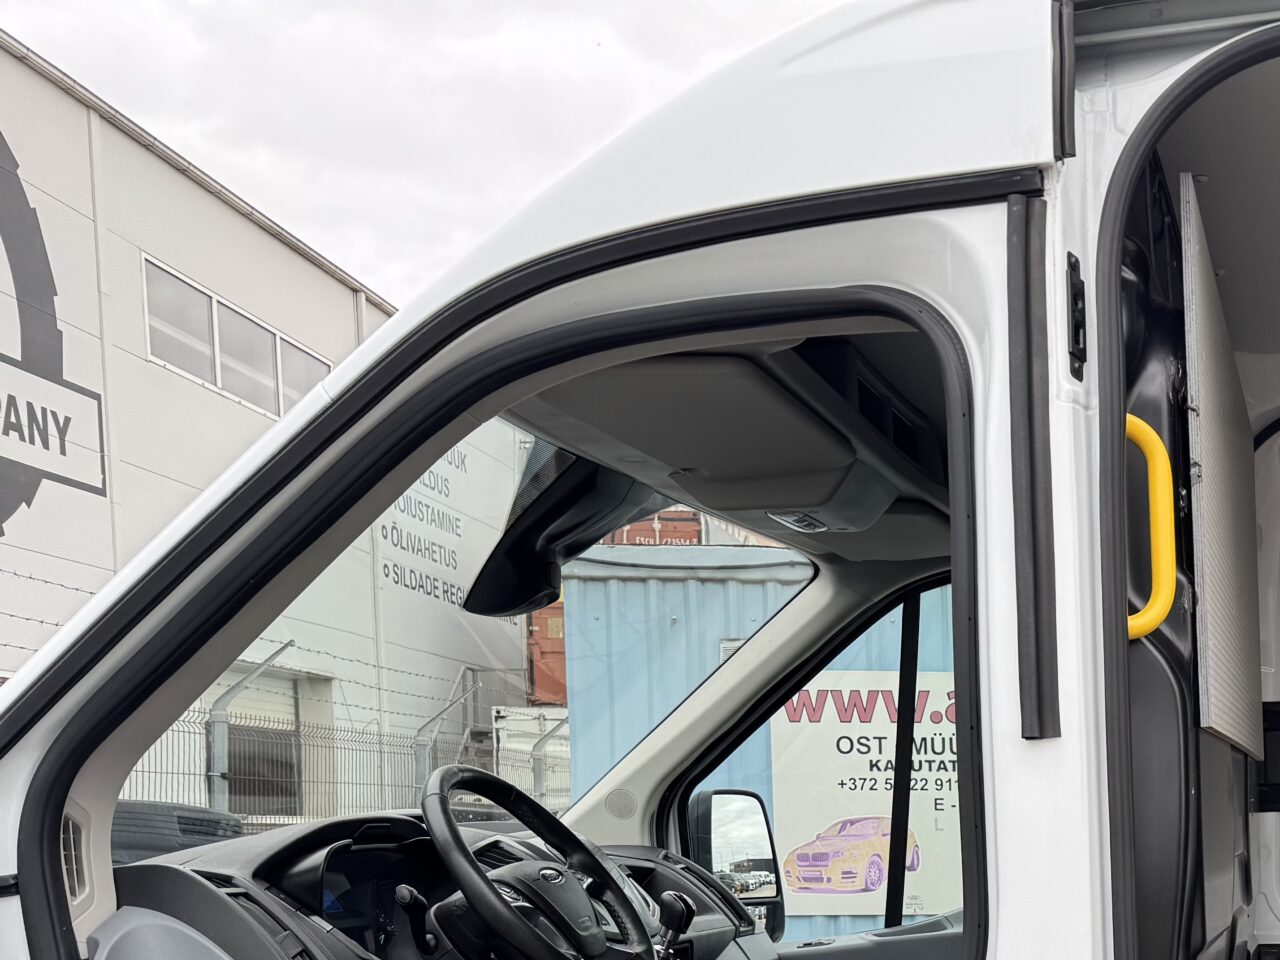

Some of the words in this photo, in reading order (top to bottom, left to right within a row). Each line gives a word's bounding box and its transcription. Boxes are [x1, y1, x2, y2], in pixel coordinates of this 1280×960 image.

[0, 393, 72, 457] ANY
[420, 469, 450, 498] LDUS
[394, 494, 462, 538] OIUSTAMINE
[391, 520, 458, 571] ÕLIVAHETUS
[392, 563, 440, 600] SILDADE
[836, 735, 888, 755] OST
[837, 777, 878, 791] +372
